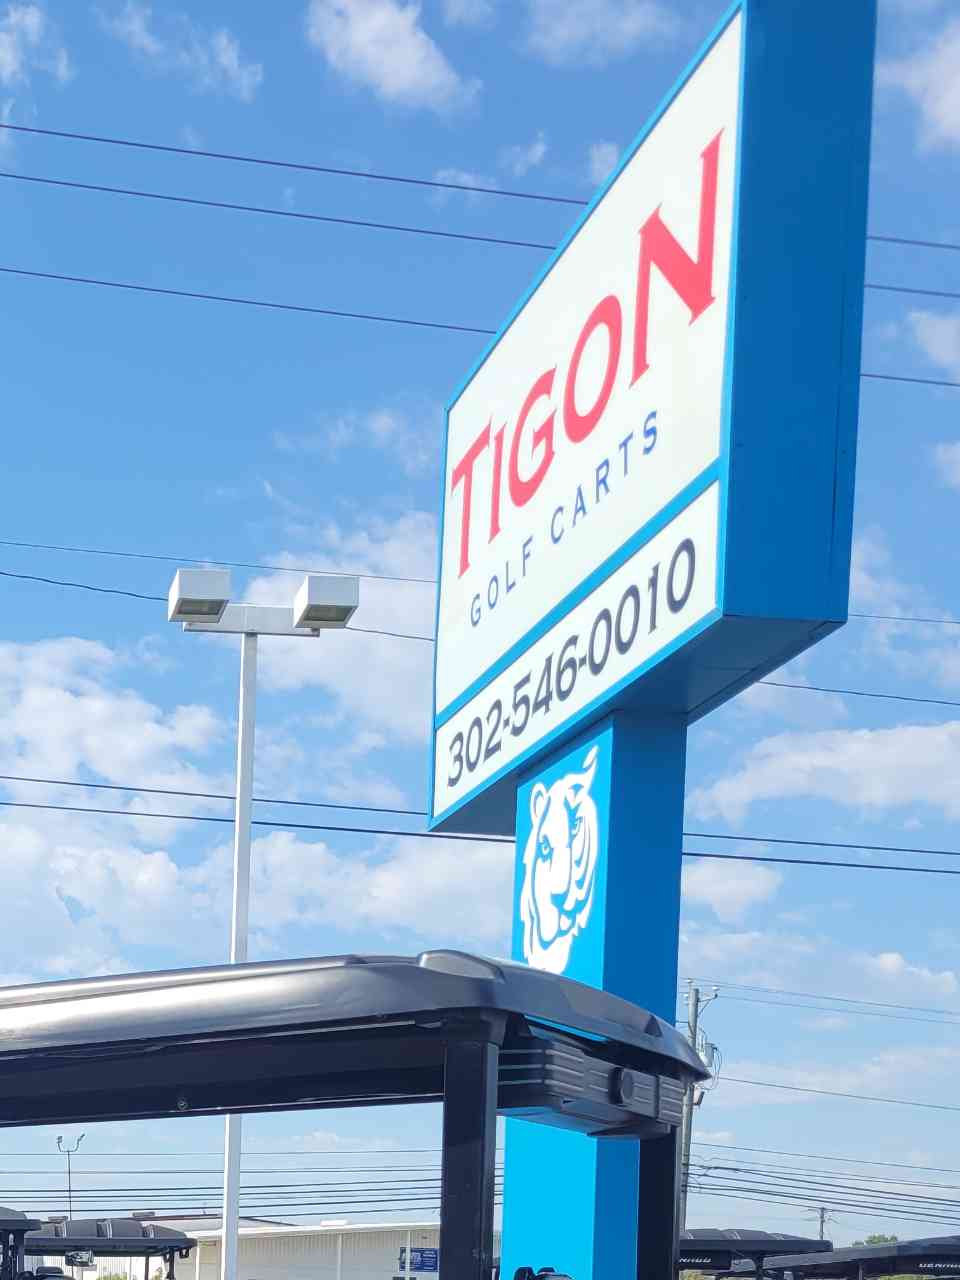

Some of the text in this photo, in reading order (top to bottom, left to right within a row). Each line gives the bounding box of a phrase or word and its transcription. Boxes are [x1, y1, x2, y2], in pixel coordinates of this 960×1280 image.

[451, 128, 725, 578] TIGON
[470, 409, 658, 628] GOLF CARTS
[447, 537, 697, 788] 302-546-0010
